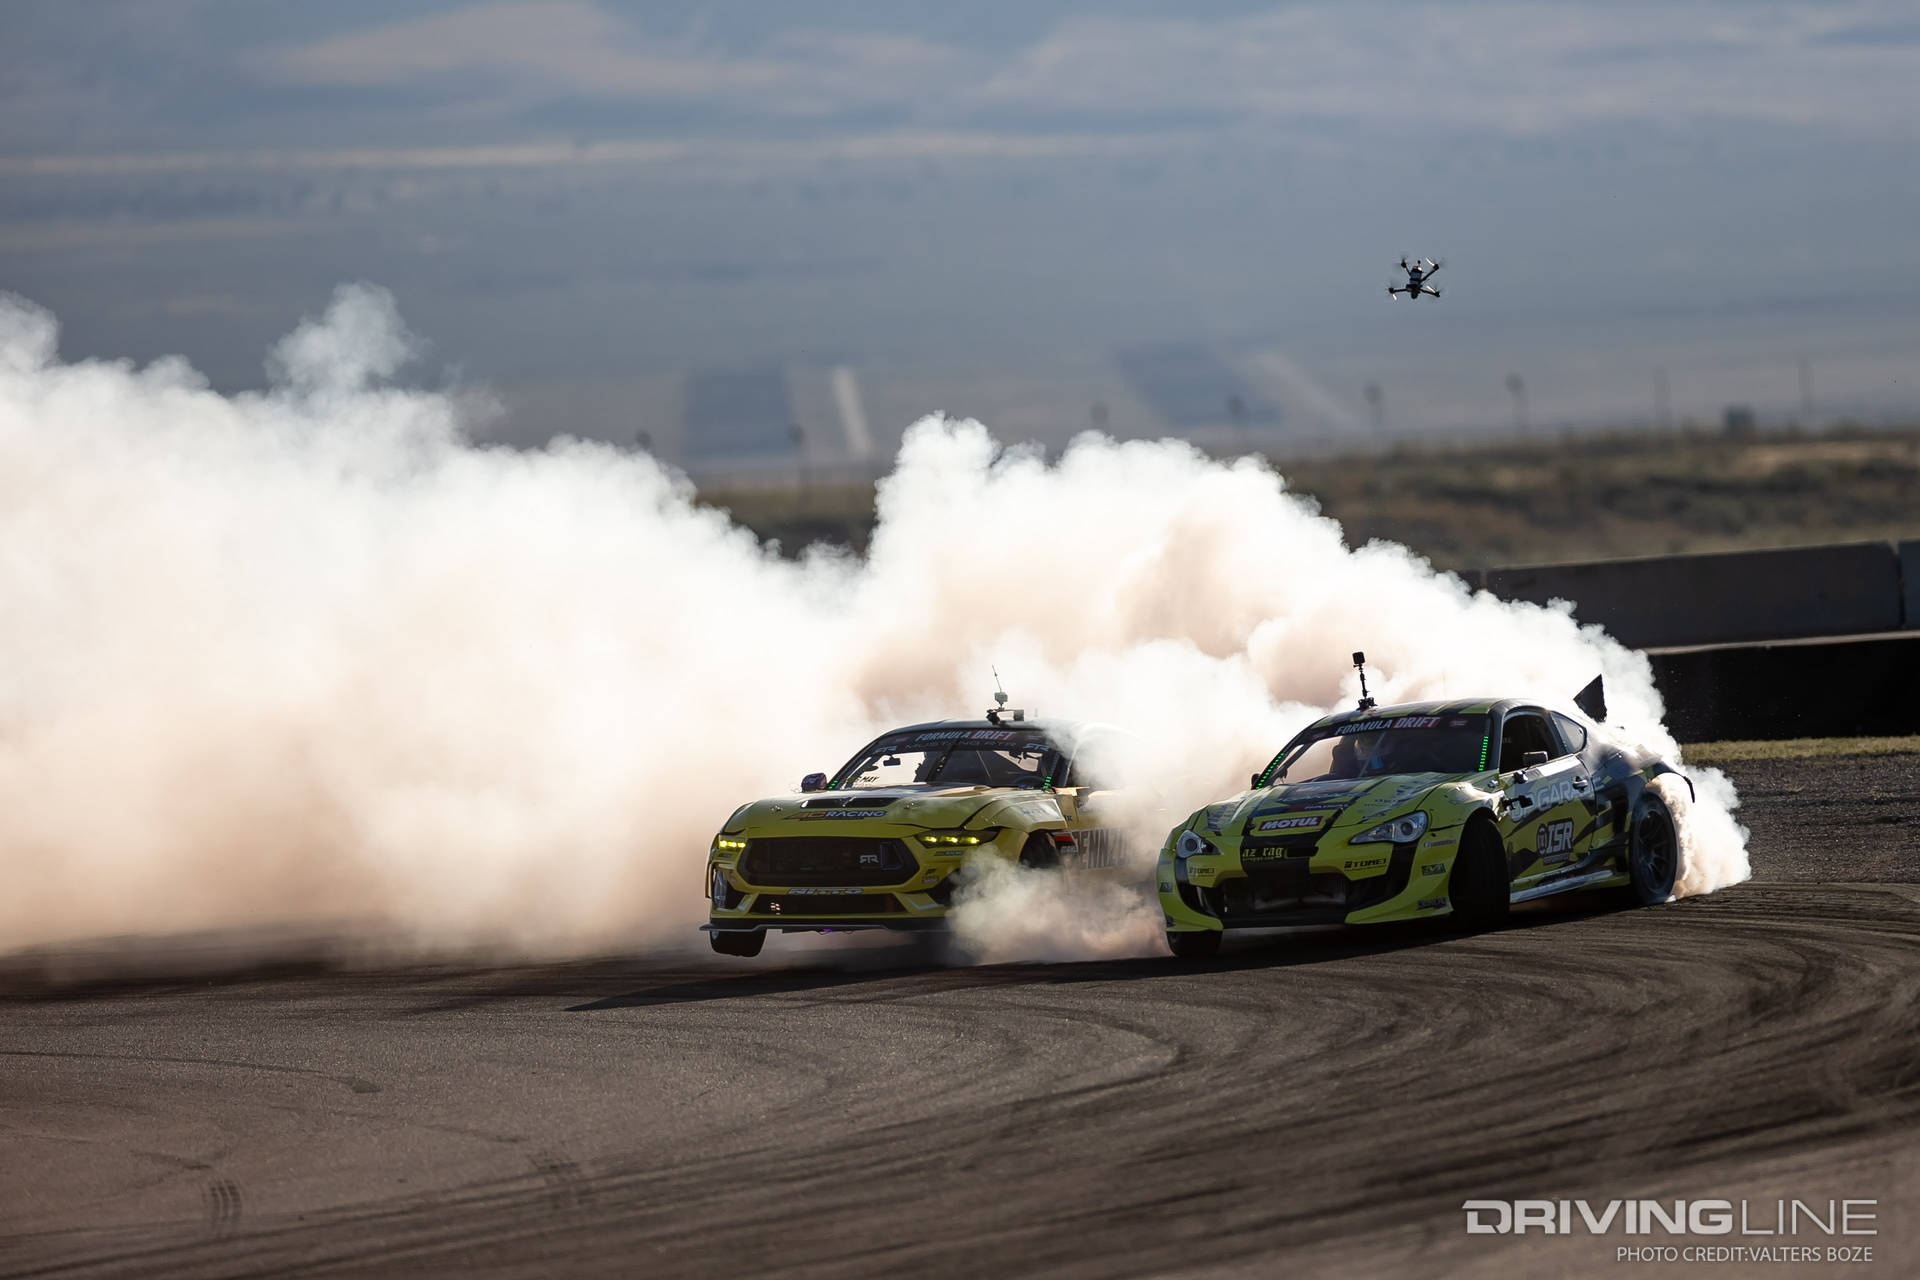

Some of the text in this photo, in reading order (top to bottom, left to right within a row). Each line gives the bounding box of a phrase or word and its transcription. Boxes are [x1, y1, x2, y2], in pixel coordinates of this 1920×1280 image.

[1334, 719, 1393, 736] FORMULA
[1394, 716, 1441, 729] DRIFT
[915, 729, 1016, 742] FORMULA DRIFT
[1260, 817, 1319, 830] MOTUL
[1546, 821, 1573, 854] ISR
